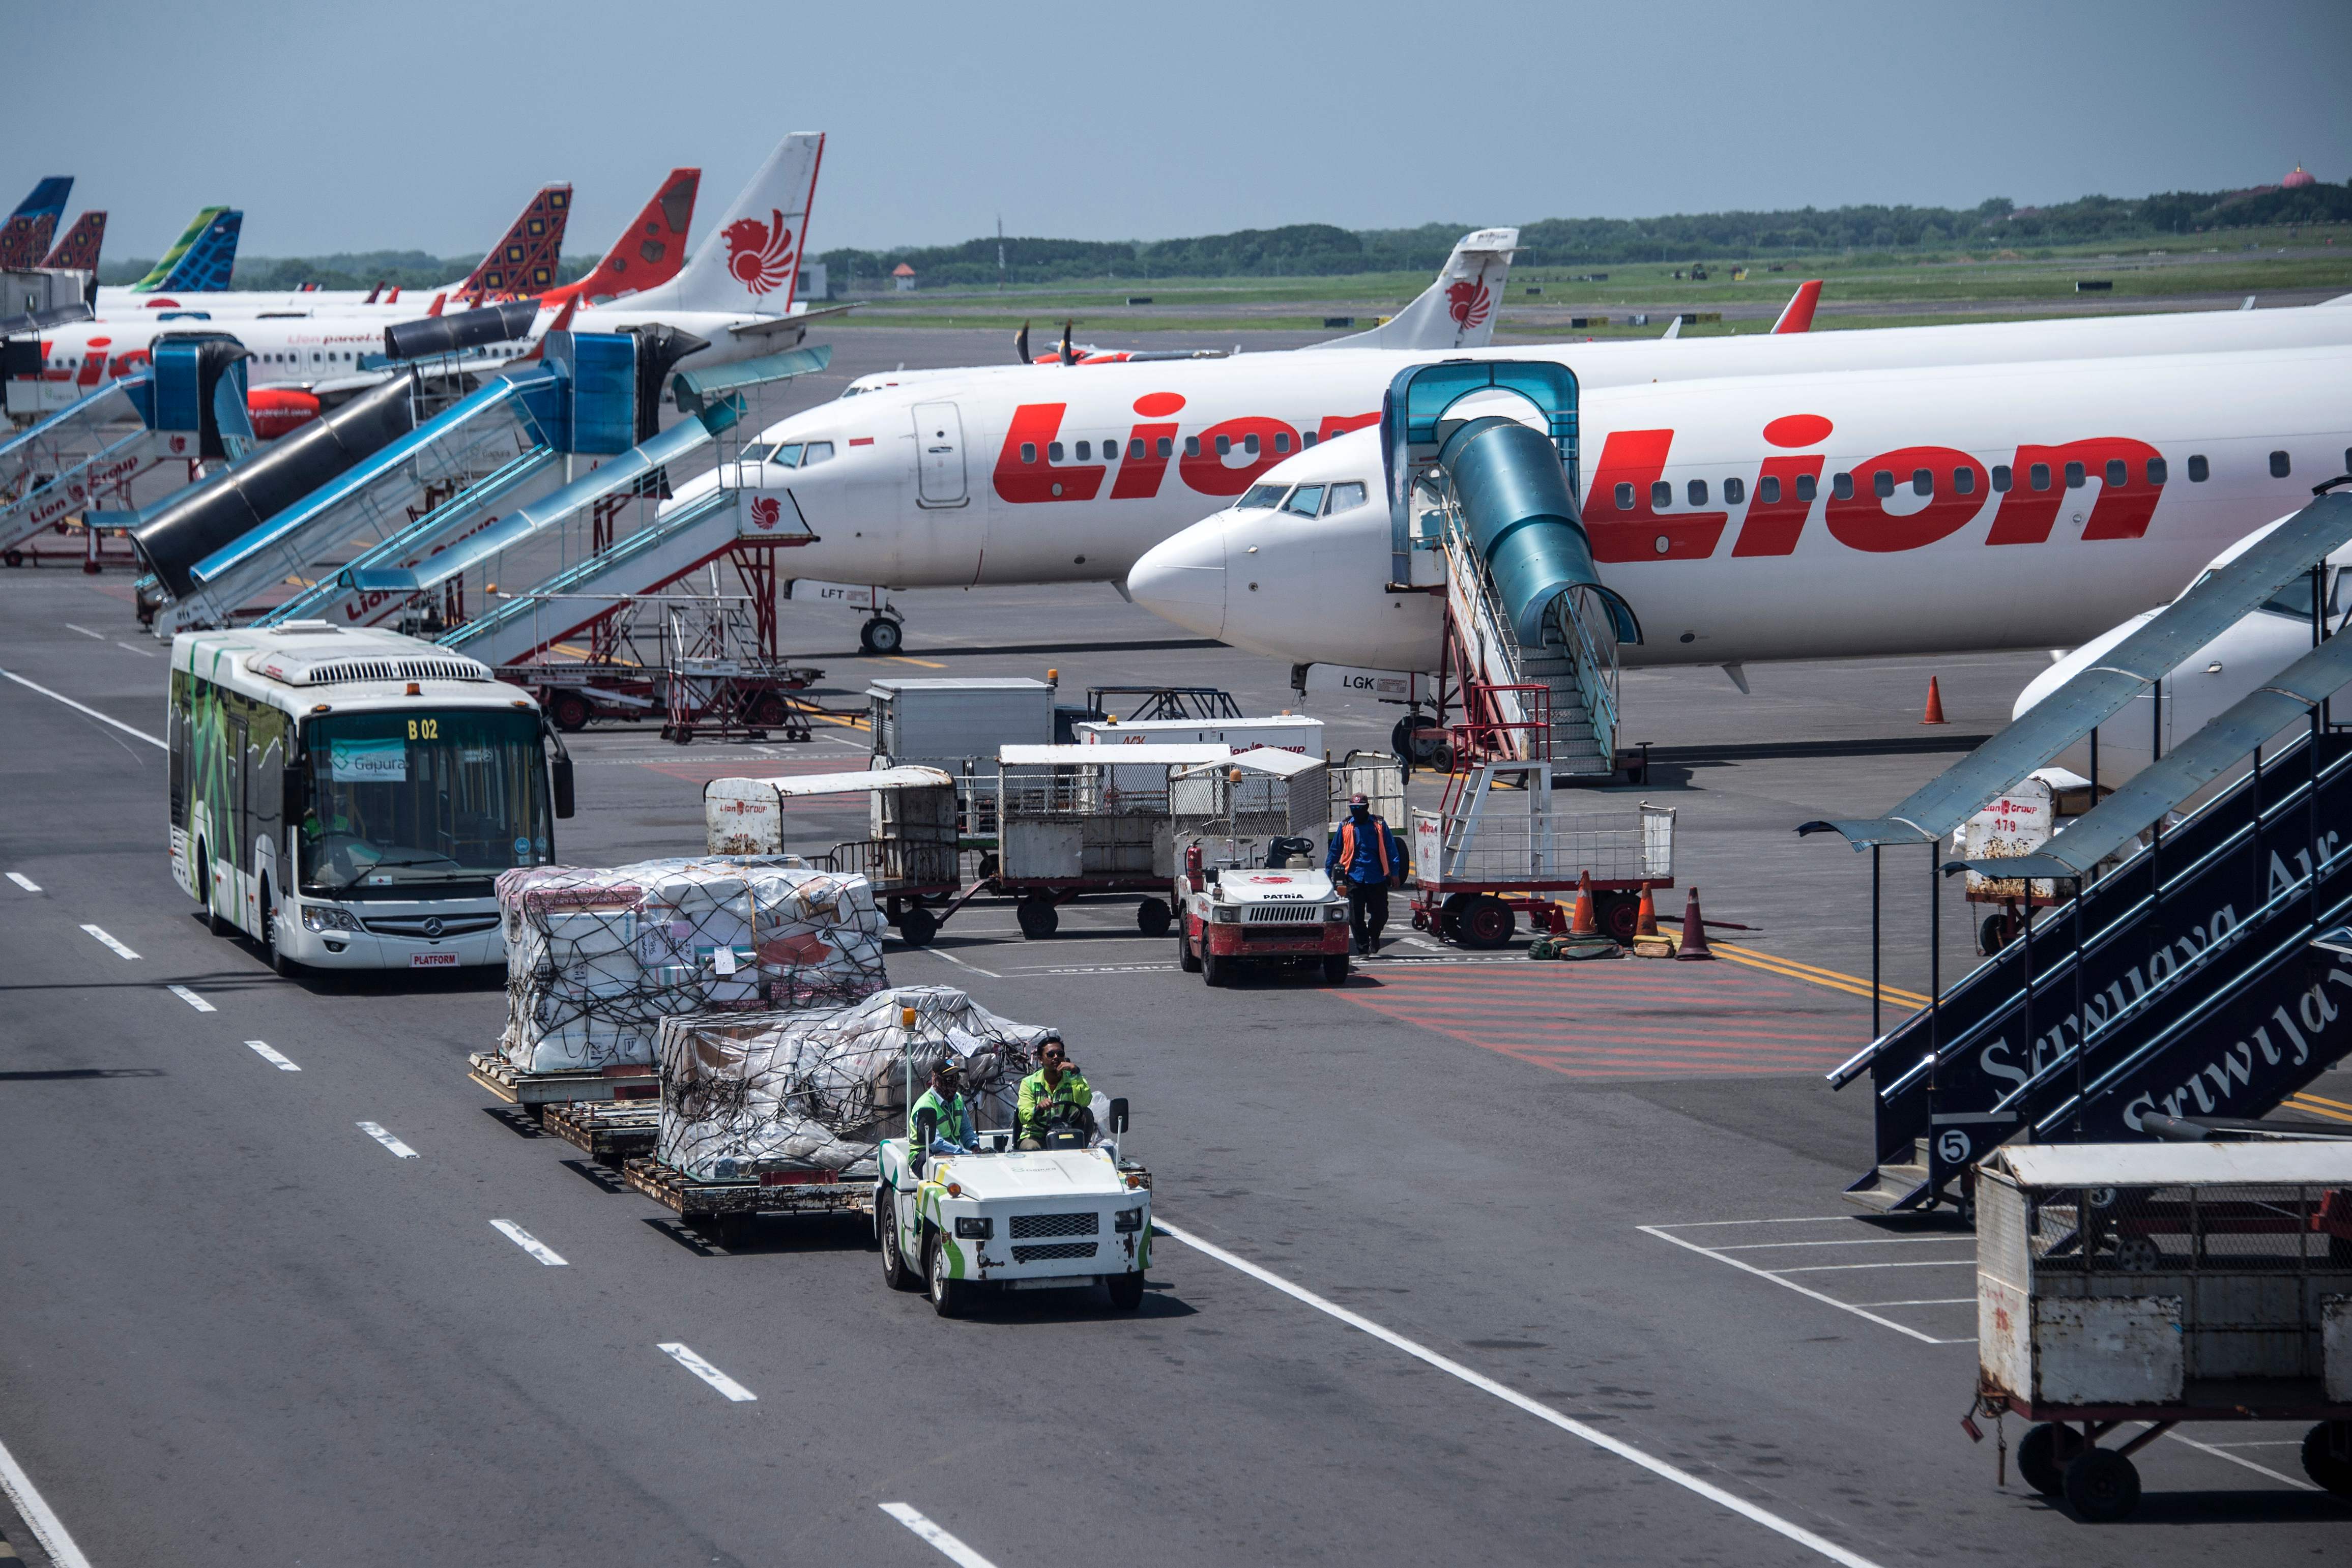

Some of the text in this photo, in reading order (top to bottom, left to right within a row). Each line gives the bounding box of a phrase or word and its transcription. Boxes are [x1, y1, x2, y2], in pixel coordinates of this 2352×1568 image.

[1580, 414, 2165, 564] Lion
[30, 498, 67, 524] Lion
[822, 588, 844, 599] LFT
[1343, 675, 1375, 690] LGK
[408, 719, 438, 740] B 02
[1230, 746, 1249, 756] ion
[355, 757, 406, 773] Gapura
[1995, 818, 2016, 832] 179
[2266, 830, 2339, 920] Air
[414, 954, 455, 965] PLATFORM
[1944, 1134, 1964, 1161] 5
